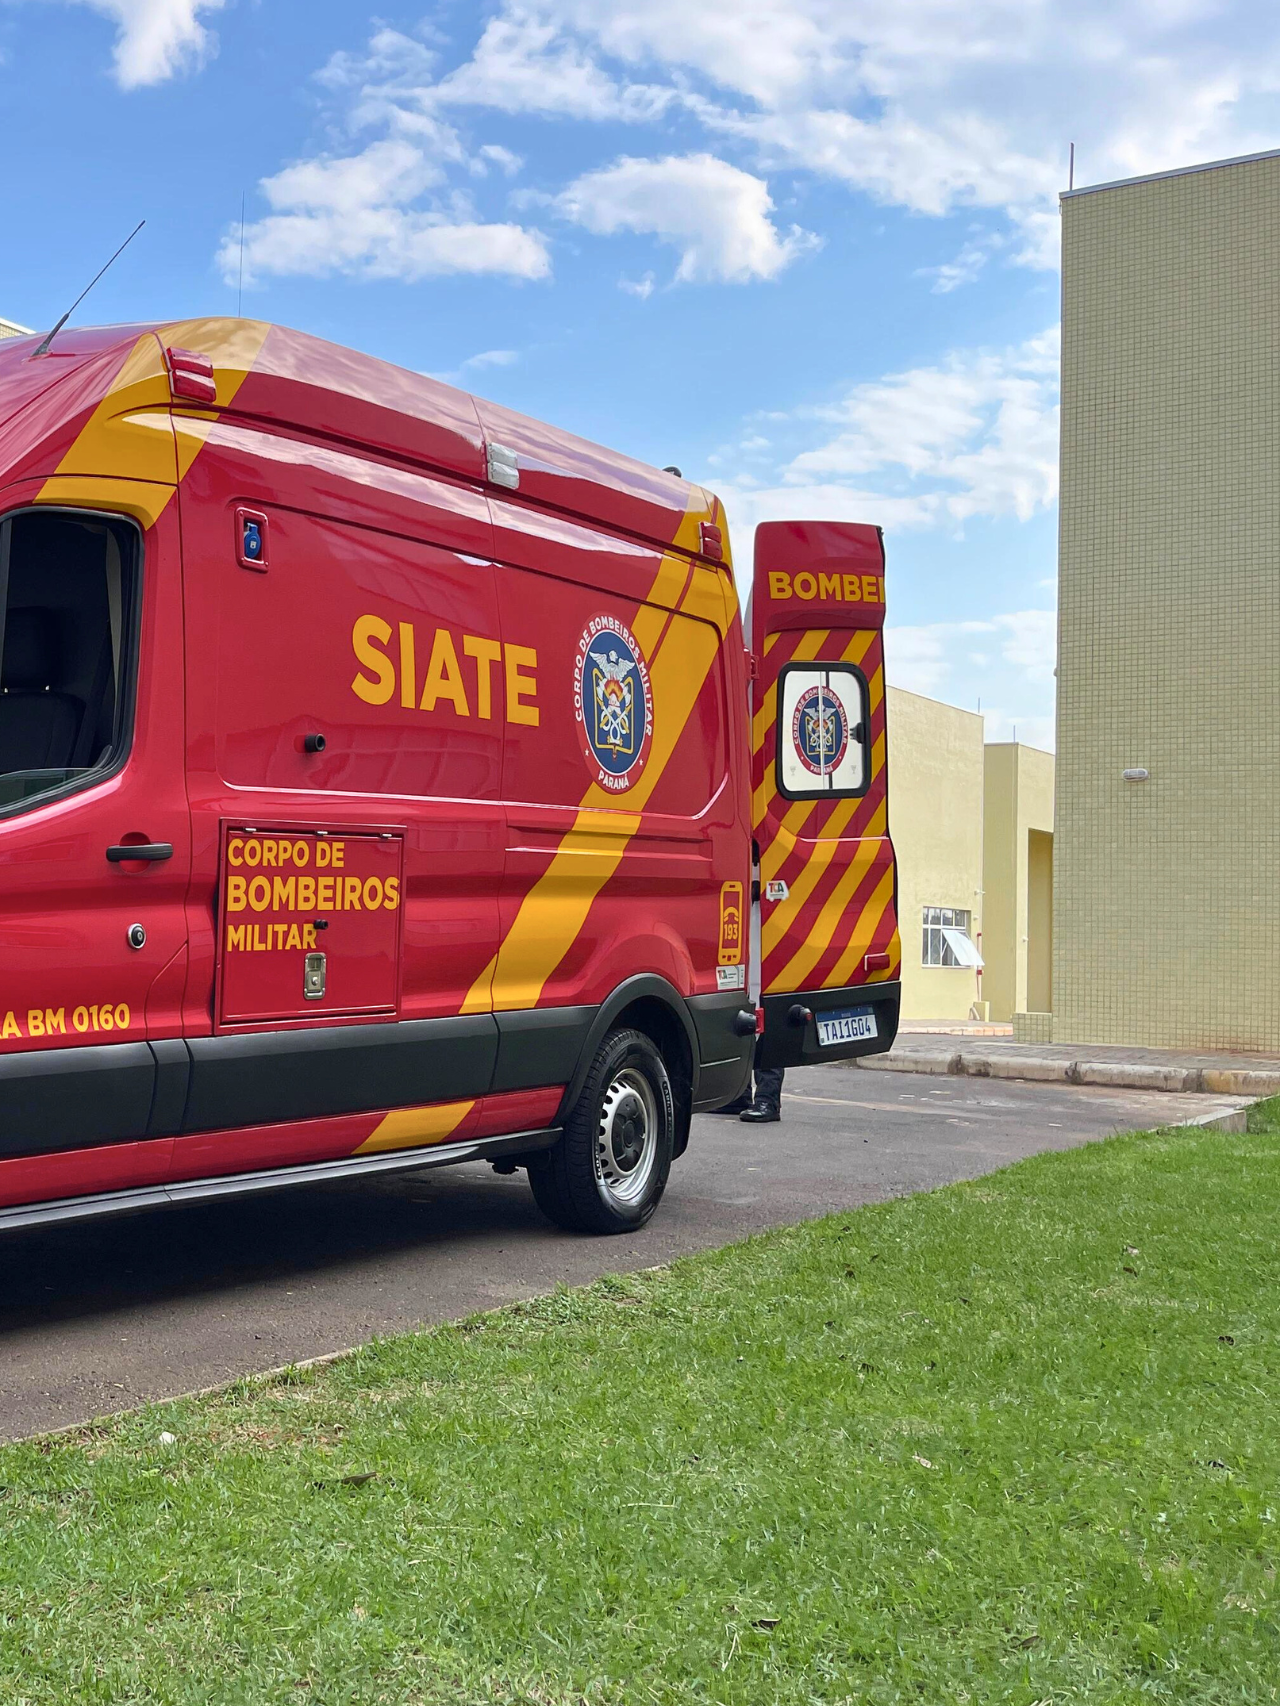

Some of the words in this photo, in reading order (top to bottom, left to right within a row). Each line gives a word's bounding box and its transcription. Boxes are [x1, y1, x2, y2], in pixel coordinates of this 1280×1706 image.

[351, 614, 540, 727] SIATE
[573, 654, 583, 722] CORPO
[579, 629, 591, 649] DE
[589, 615, 640, 657] BOMBEIROS
[639, 661, 653, 736] MILITAR
[598, 770, 629, 790] PARANÁ
[227, 838, 310, 868] CORPO
[315, 841, 345, 868] DE
[226, 875, 400, 912] BOMBEIROS
[226, 923, 317, 952] MILITAR
[724, 924, 738, 940] 193
[27, 1007, 67, 1037] BM
[72, 1003, 130, 1033] 0160
[823, 1017, 871, 1041] TAI1G04
